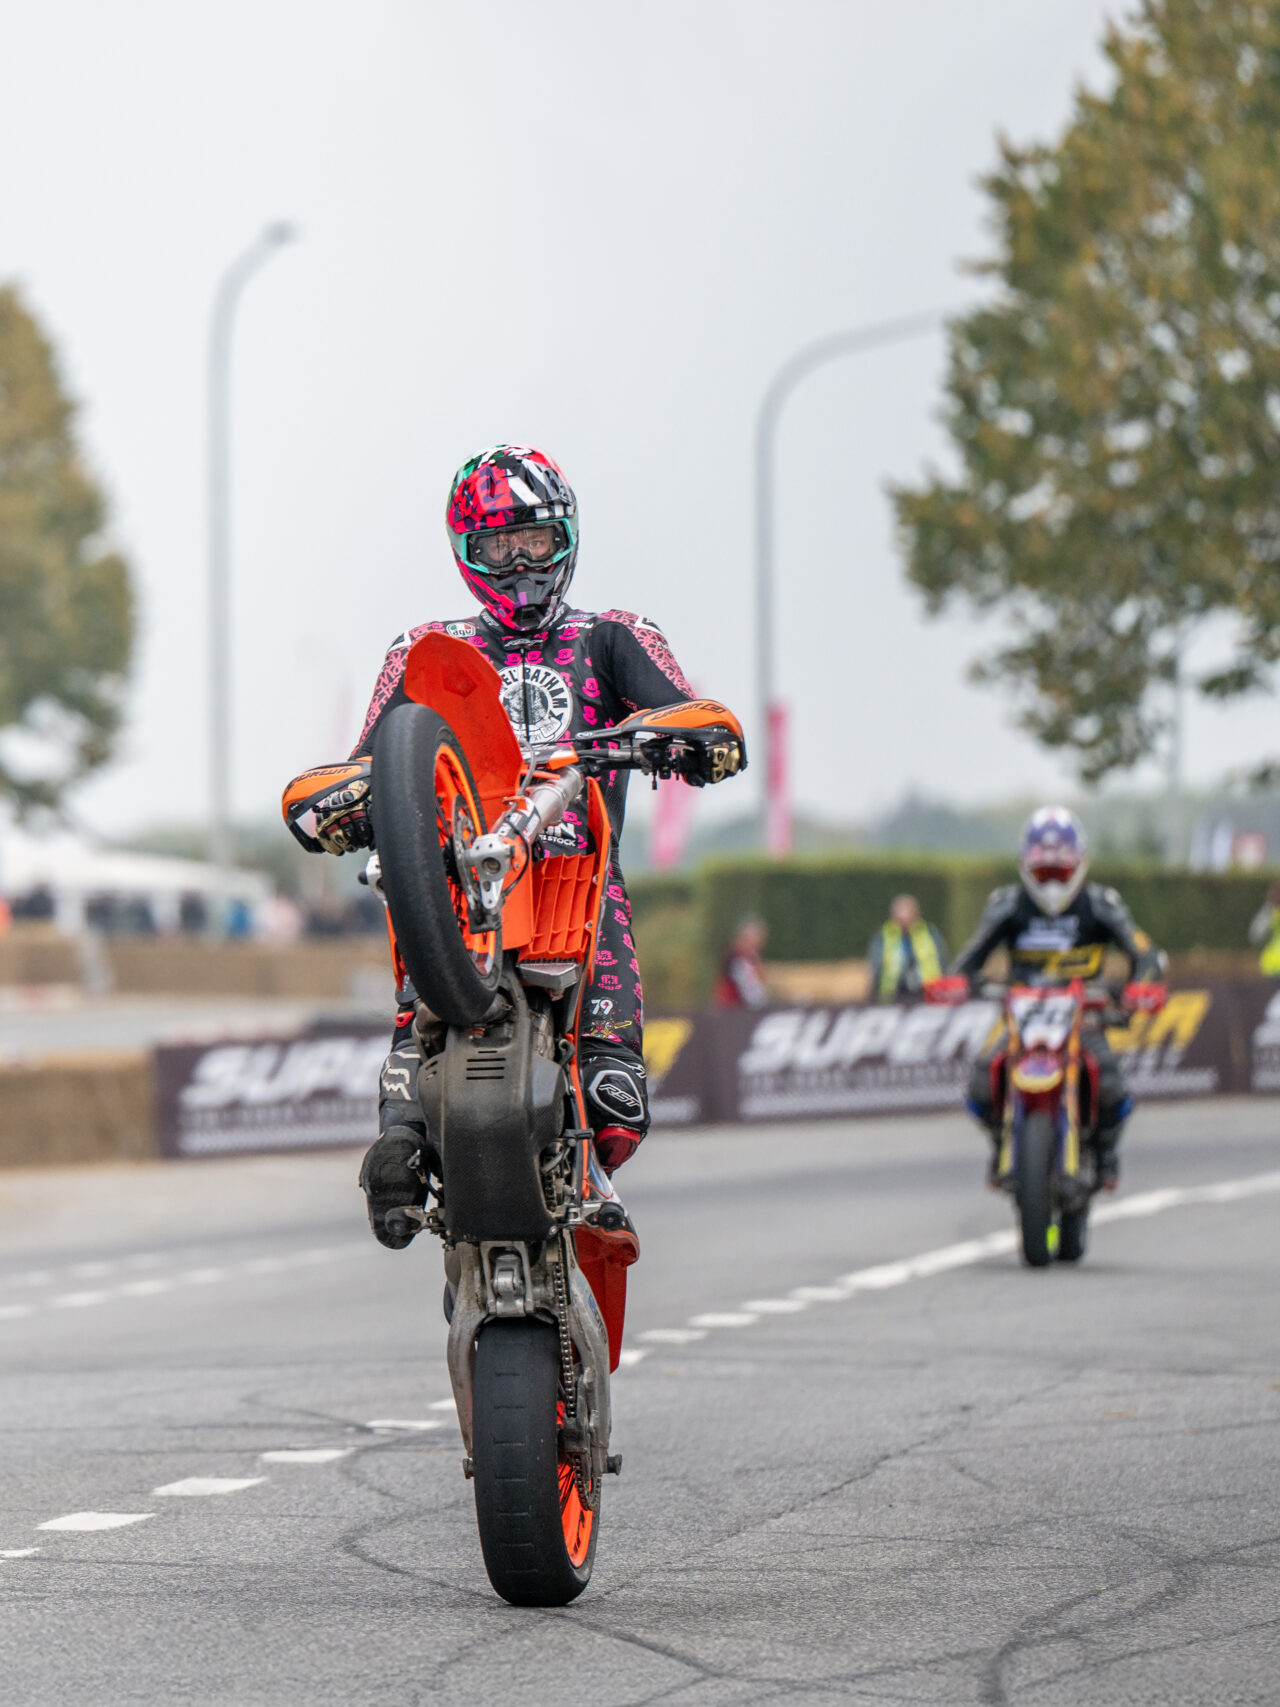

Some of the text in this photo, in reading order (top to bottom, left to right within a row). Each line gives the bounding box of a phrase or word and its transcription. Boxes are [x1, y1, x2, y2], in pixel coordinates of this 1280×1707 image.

[523, 666, 569, 709] BATHAM
[547, 835, 577, 847] STOCK
[591, 999, 613, 1015] 79
[599, 1083, 640, 1107] RST
